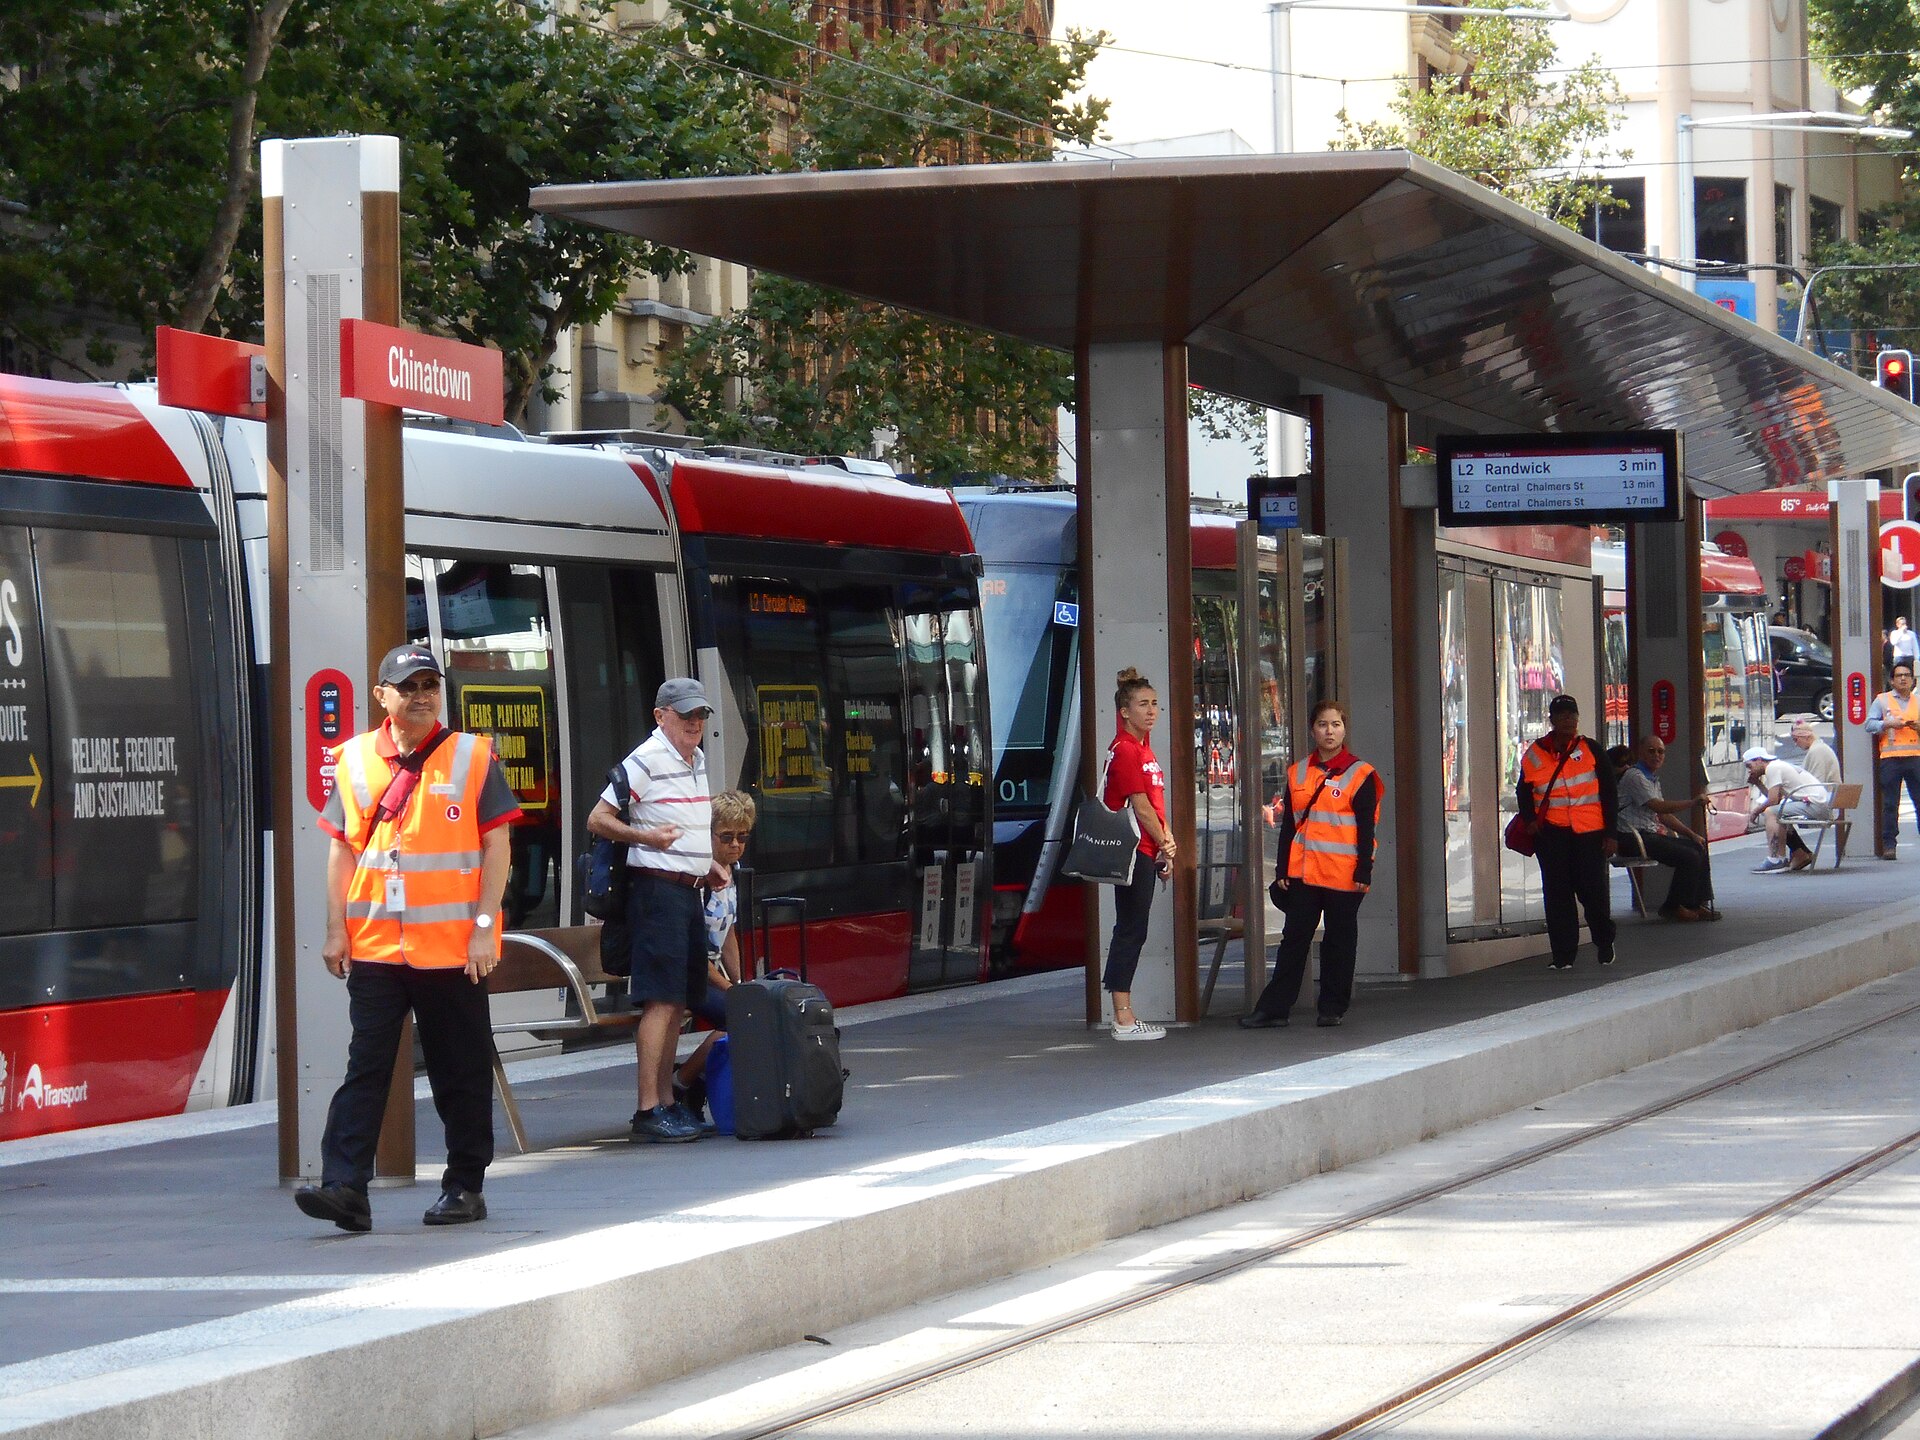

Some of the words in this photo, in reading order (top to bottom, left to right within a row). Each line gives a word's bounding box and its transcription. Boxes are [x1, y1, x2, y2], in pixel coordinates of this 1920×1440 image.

[389, 346, 471, 402] Chinatown
[1458, 464, 1474, 476] L2
[1485, 462, 1551, 475] Randwick
[1619, 460, 1627, 471] 3
[1632, 459, 1657, 471] min
[1458, 484, 1470, 493] L2
[1485, 483, 1520, 493] Central
[1527, 482, 1571, 492] Chalmers
[1573, 482, 1584, 490] St
[1623, 480, 1635, 489] 13
[1637, 480, 1655, 489] min
[1265, 502, 1279, 512] L2
[1459, 500, 1470, 509] L2
[1486, 499, 1520, 509] Central
[1527, 498, 1572, 508] Chalmers
[1574, 497, 1585, 506] St
[1625, 496, 1638, 505] 17
[1640, 495, 1659, 504] min
[1, 579, 23, 667] S
[321, 690, 338, 698] opal
[469, 704, 493, 728] HEADS
[496, 704, 513, 728] PLAY
[514, 704, 521, 728] IT
[521, 704, 539, 728] SAFE
[72, 738, 124, 777] RELIABLE,
[125, 737, 178, 776] FREQUENT,
[520, 767, 536, 790] RAIL
[999, 779, 1029, 801] 01
[74, 783, 96, 819] AND
[98, 781, 165, 819] SUSTAINABLE
[450, 808, 457, 818] L
[44, 1080, 88, 1108] Transport
